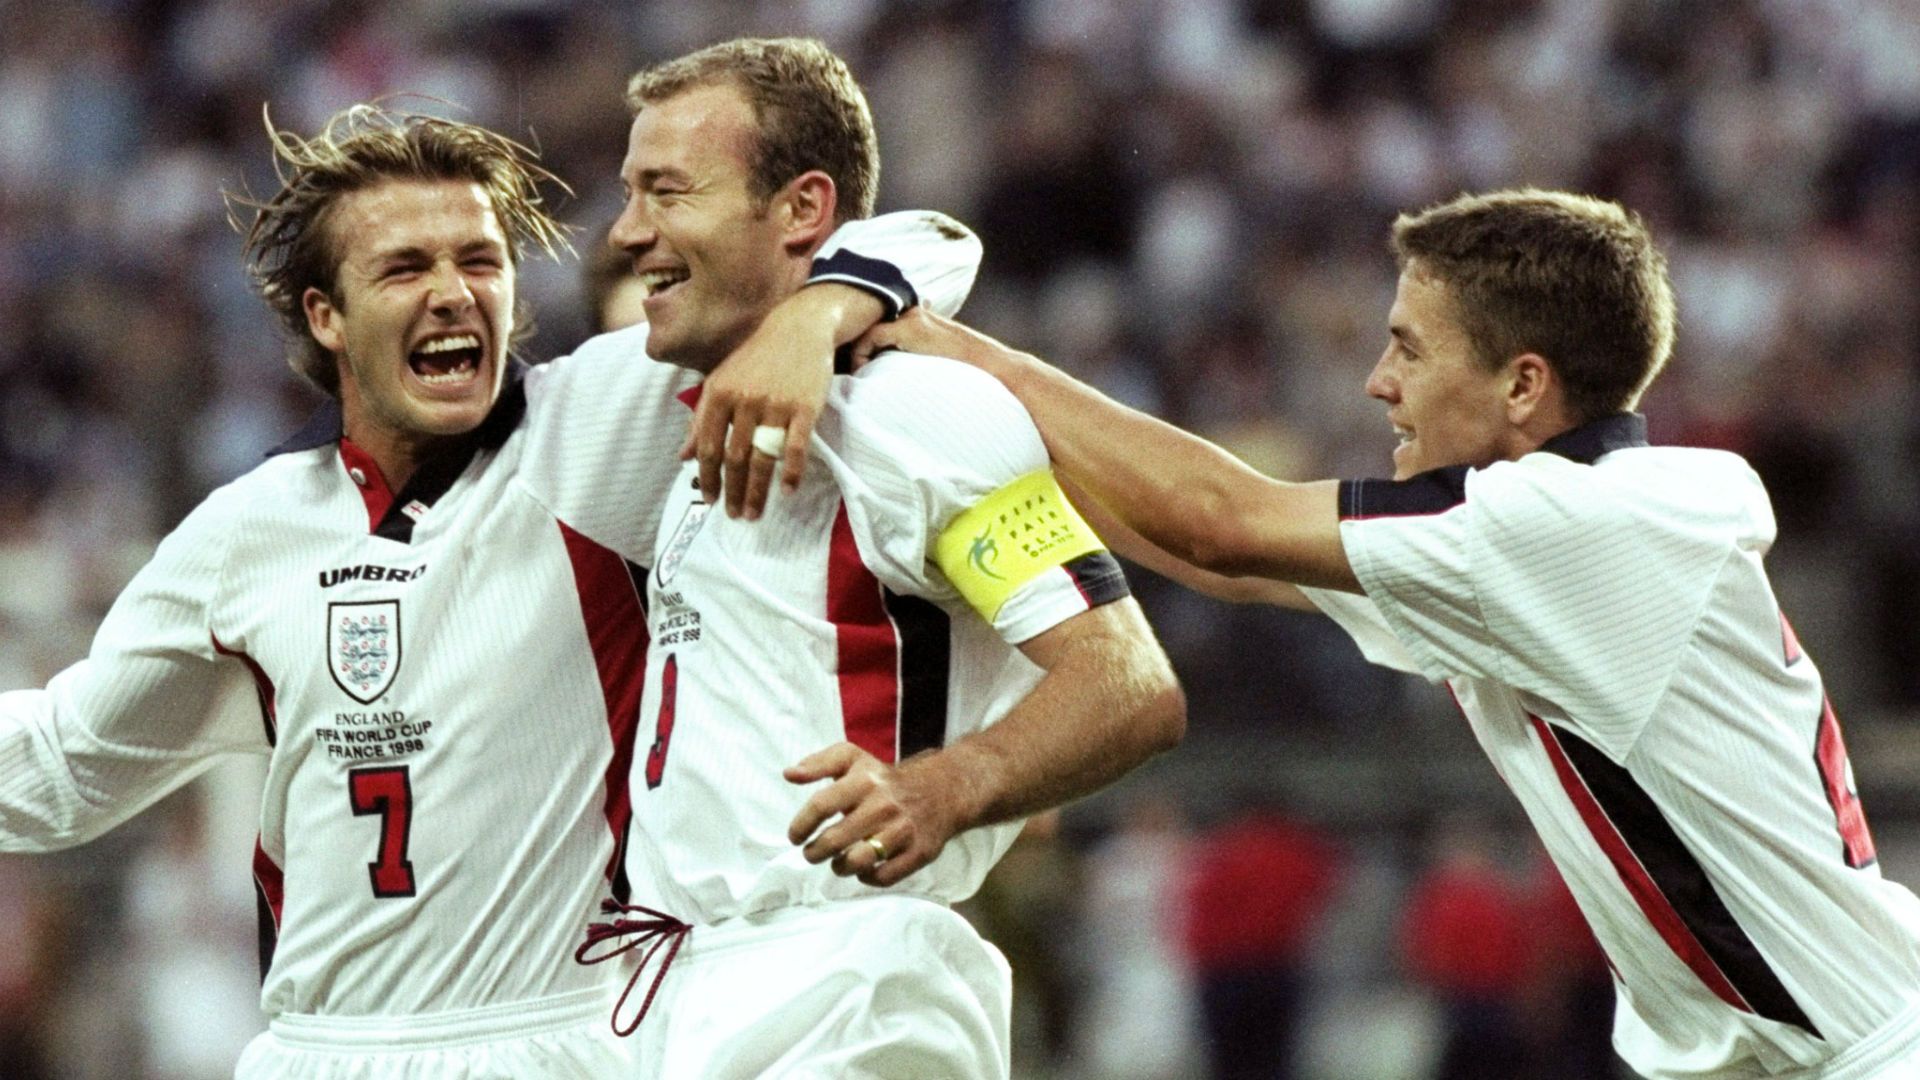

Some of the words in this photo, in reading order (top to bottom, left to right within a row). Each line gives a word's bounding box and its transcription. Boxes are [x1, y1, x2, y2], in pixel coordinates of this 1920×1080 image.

[999, 494, 1046, 525] FIFA
[1009, 510, 1057, 540] FAIR
[1021, 525, 1069, 553] PLAY
[319, 564, 427, 588] UMBRO
[316, 728, 341, 743] FIFA
[342, 727, 397, 743] WORLD
[400, 720, 432, 738] CUP
[335, 711, 404, 726] ENGLAND
[328, 744, 385, 759] FRANCE
[388, 739, 425, 756] 1998
[348, 764, 416, 899] 7
